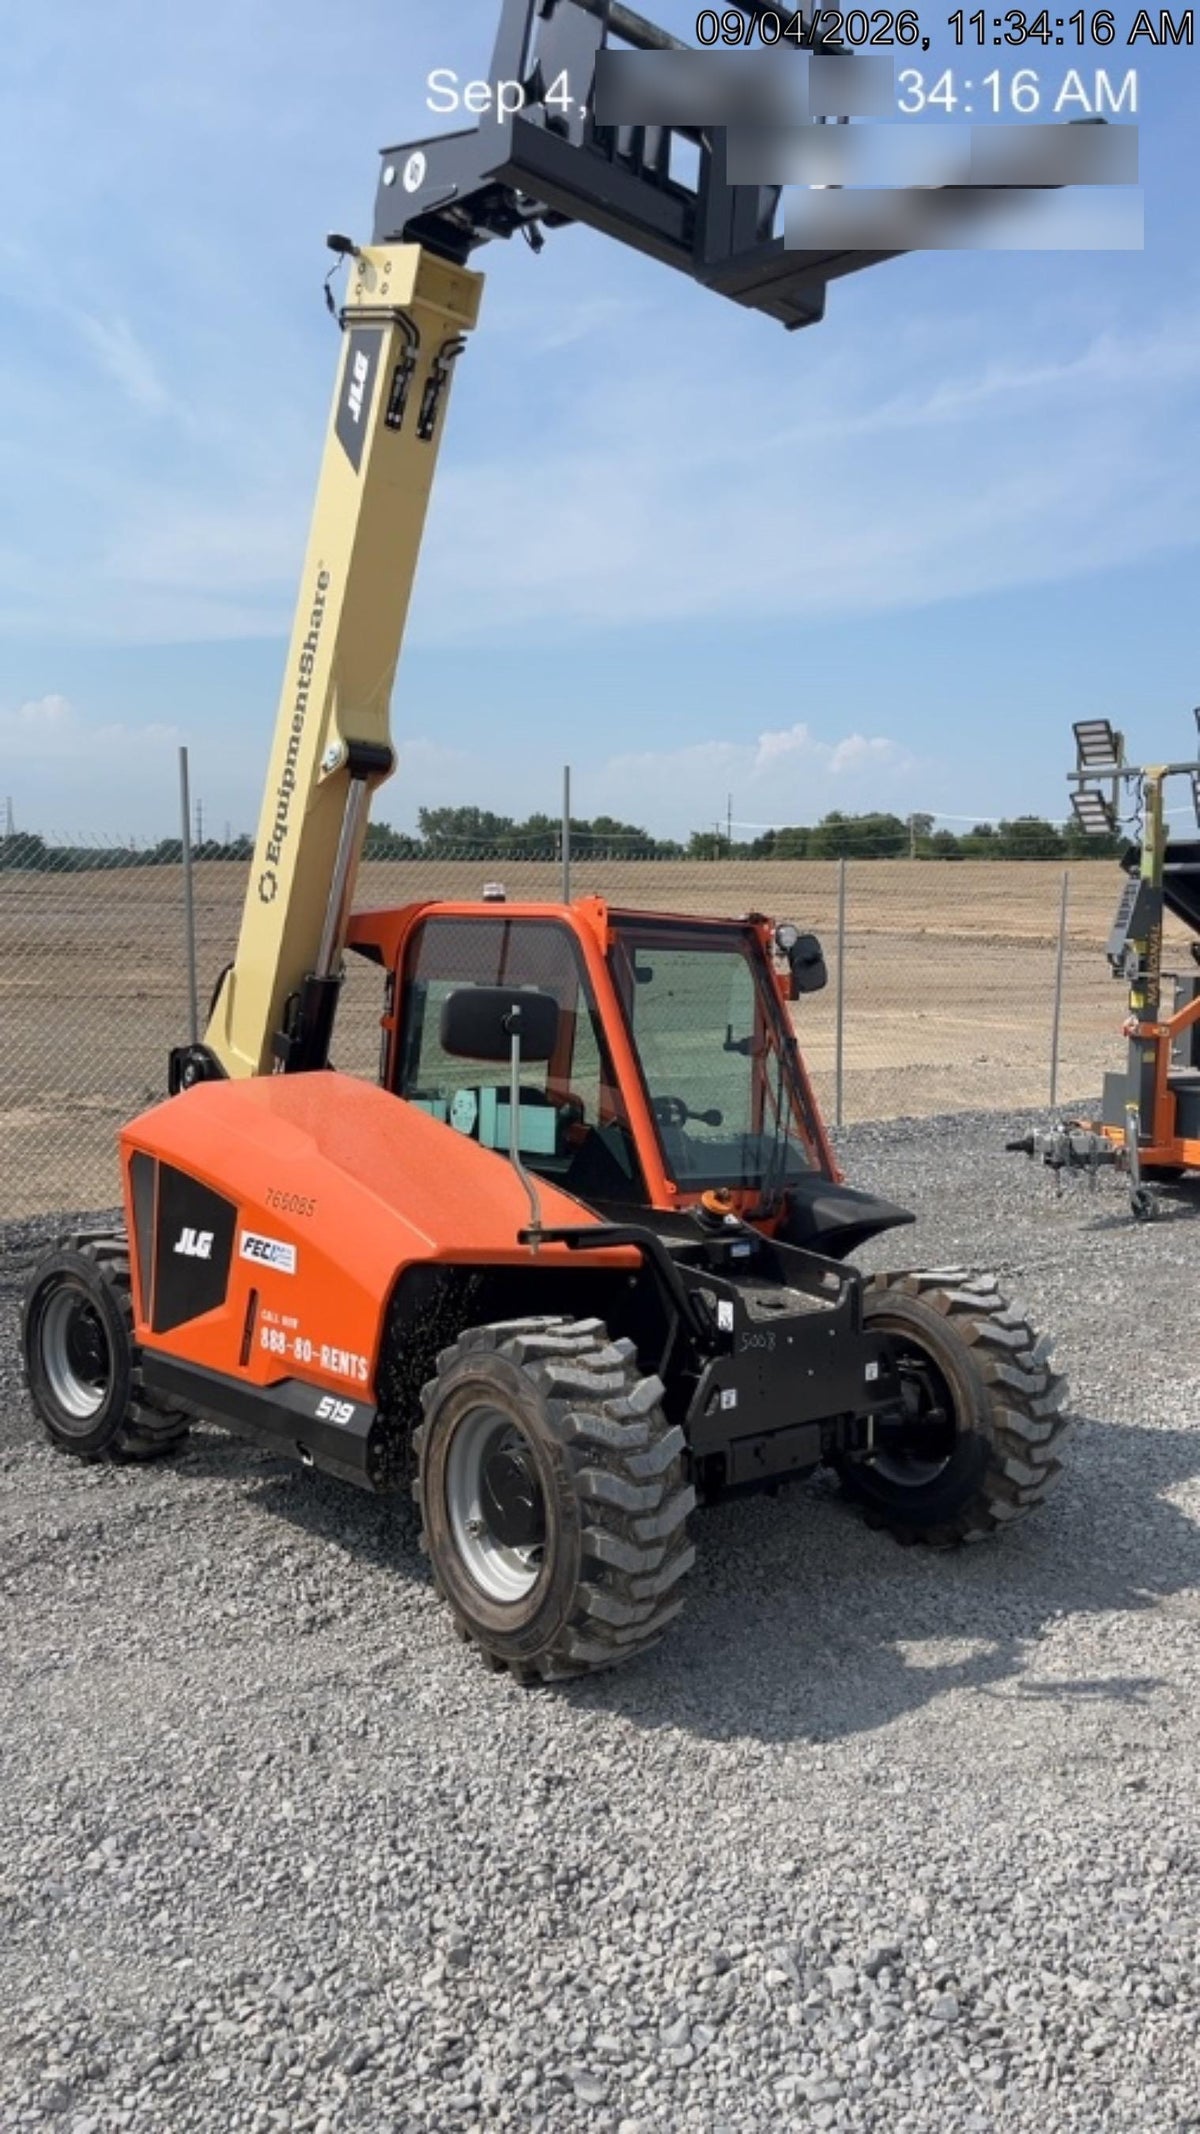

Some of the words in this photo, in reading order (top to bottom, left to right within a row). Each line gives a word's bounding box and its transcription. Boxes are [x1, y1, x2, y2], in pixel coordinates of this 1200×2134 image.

[348, 350, 369, 424] JLG
[265, 571, 331, 865] EquipmentShare
[173, 1227, 214, 1259] JLG
[260, 1326, 368, 1381] 888-80-RENTS
